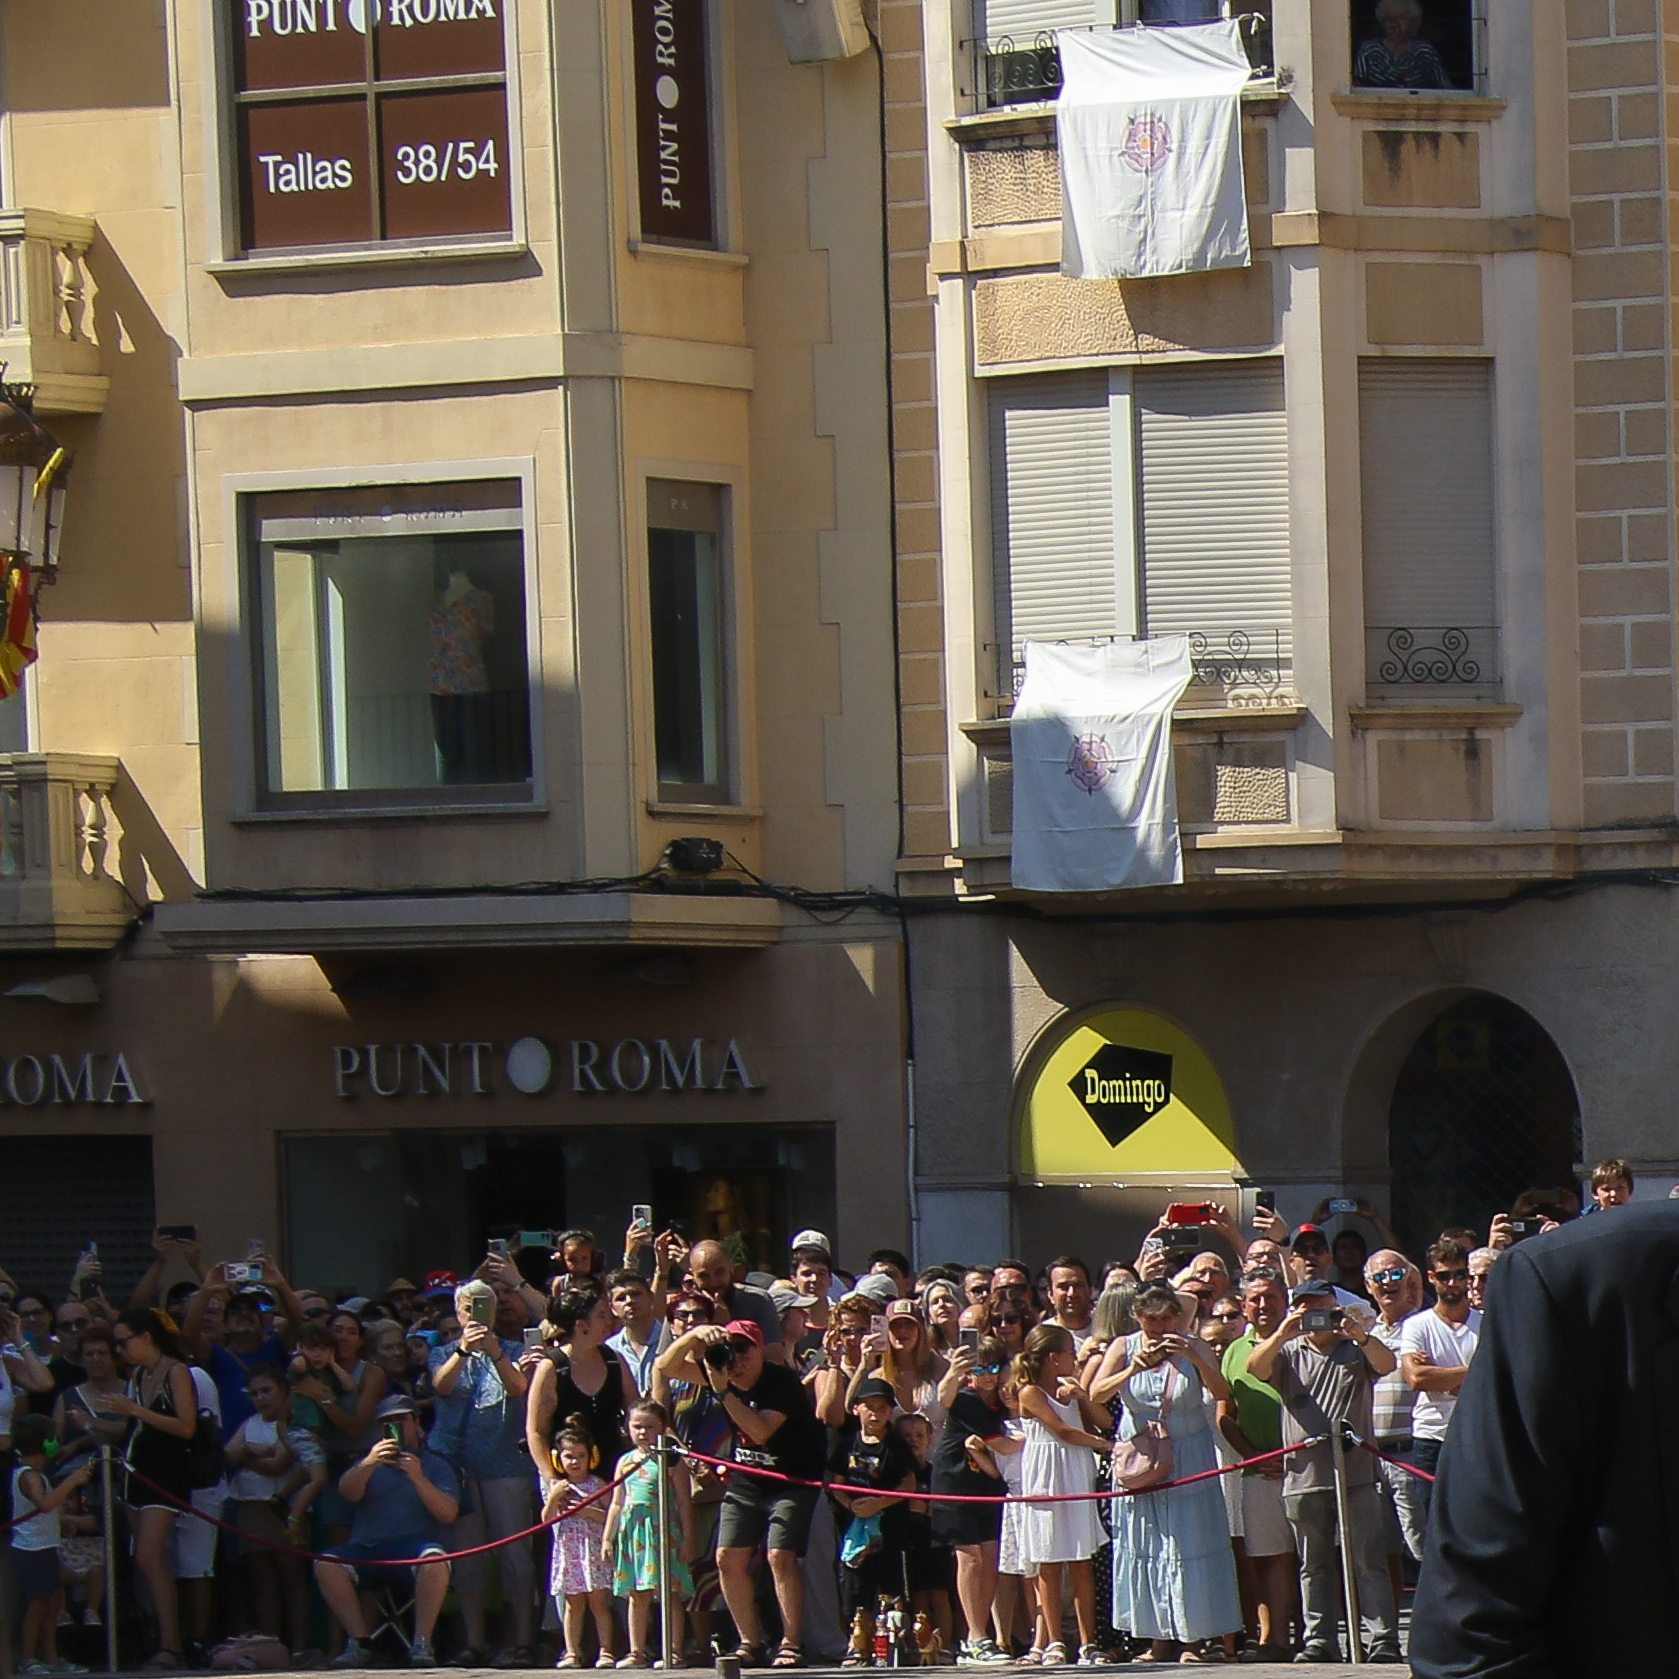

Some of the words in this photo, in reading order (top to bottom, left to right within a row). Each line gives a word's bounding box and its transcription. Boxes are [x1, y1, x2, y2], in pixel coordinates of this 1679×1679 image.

[653, 0, 677, 67] ROM
[258, 152, 353, 194] Tallas
[395, 139, 499, 185] 38/54
[657, 112, 682, 210] PUNT
[0, 1052, 144, 1105] OMA
[332, 1041, 494, 1096] PUNT
[570, 1037, 758, 1091] ROMA
[1084, 1068, 1165, 1113] Domingo
